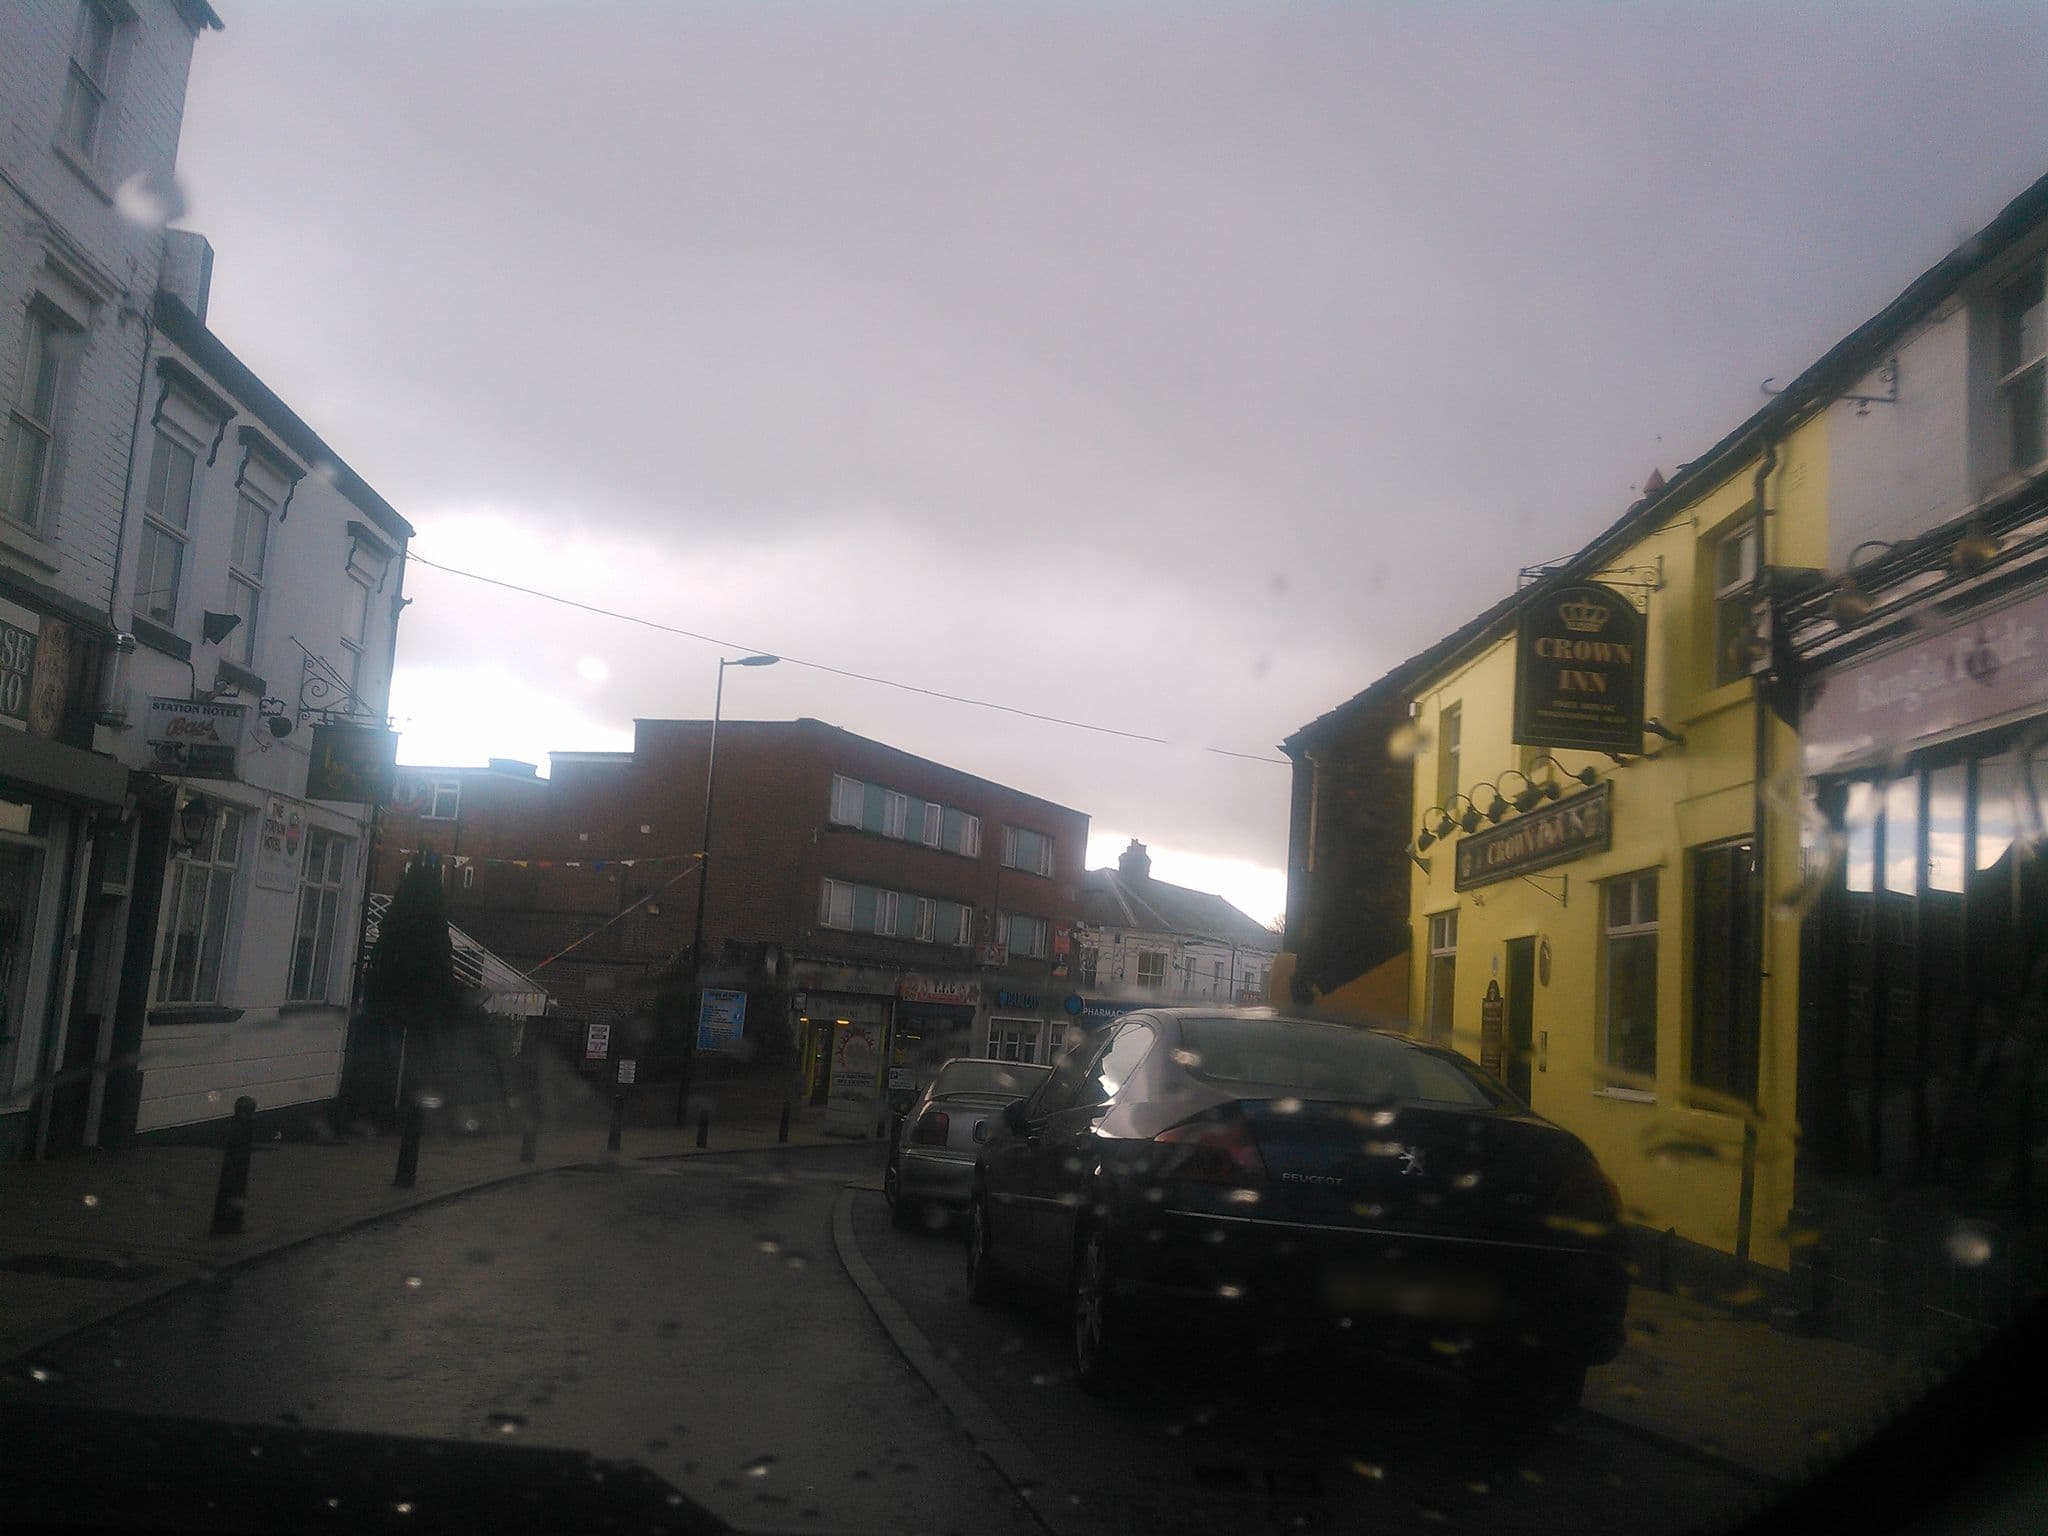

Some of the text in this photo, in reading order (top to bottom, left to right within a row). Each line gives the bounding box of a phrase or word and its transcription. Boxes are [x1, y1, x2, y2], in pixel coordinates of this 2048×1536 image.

[1533, 637, 1632, 664] CROWN
[1558, 669, 1607, 693] INN
[152, 702, 240, 718] STATION HOTEL
[1281, 1172, 1345, 1185] PEUGEOT
